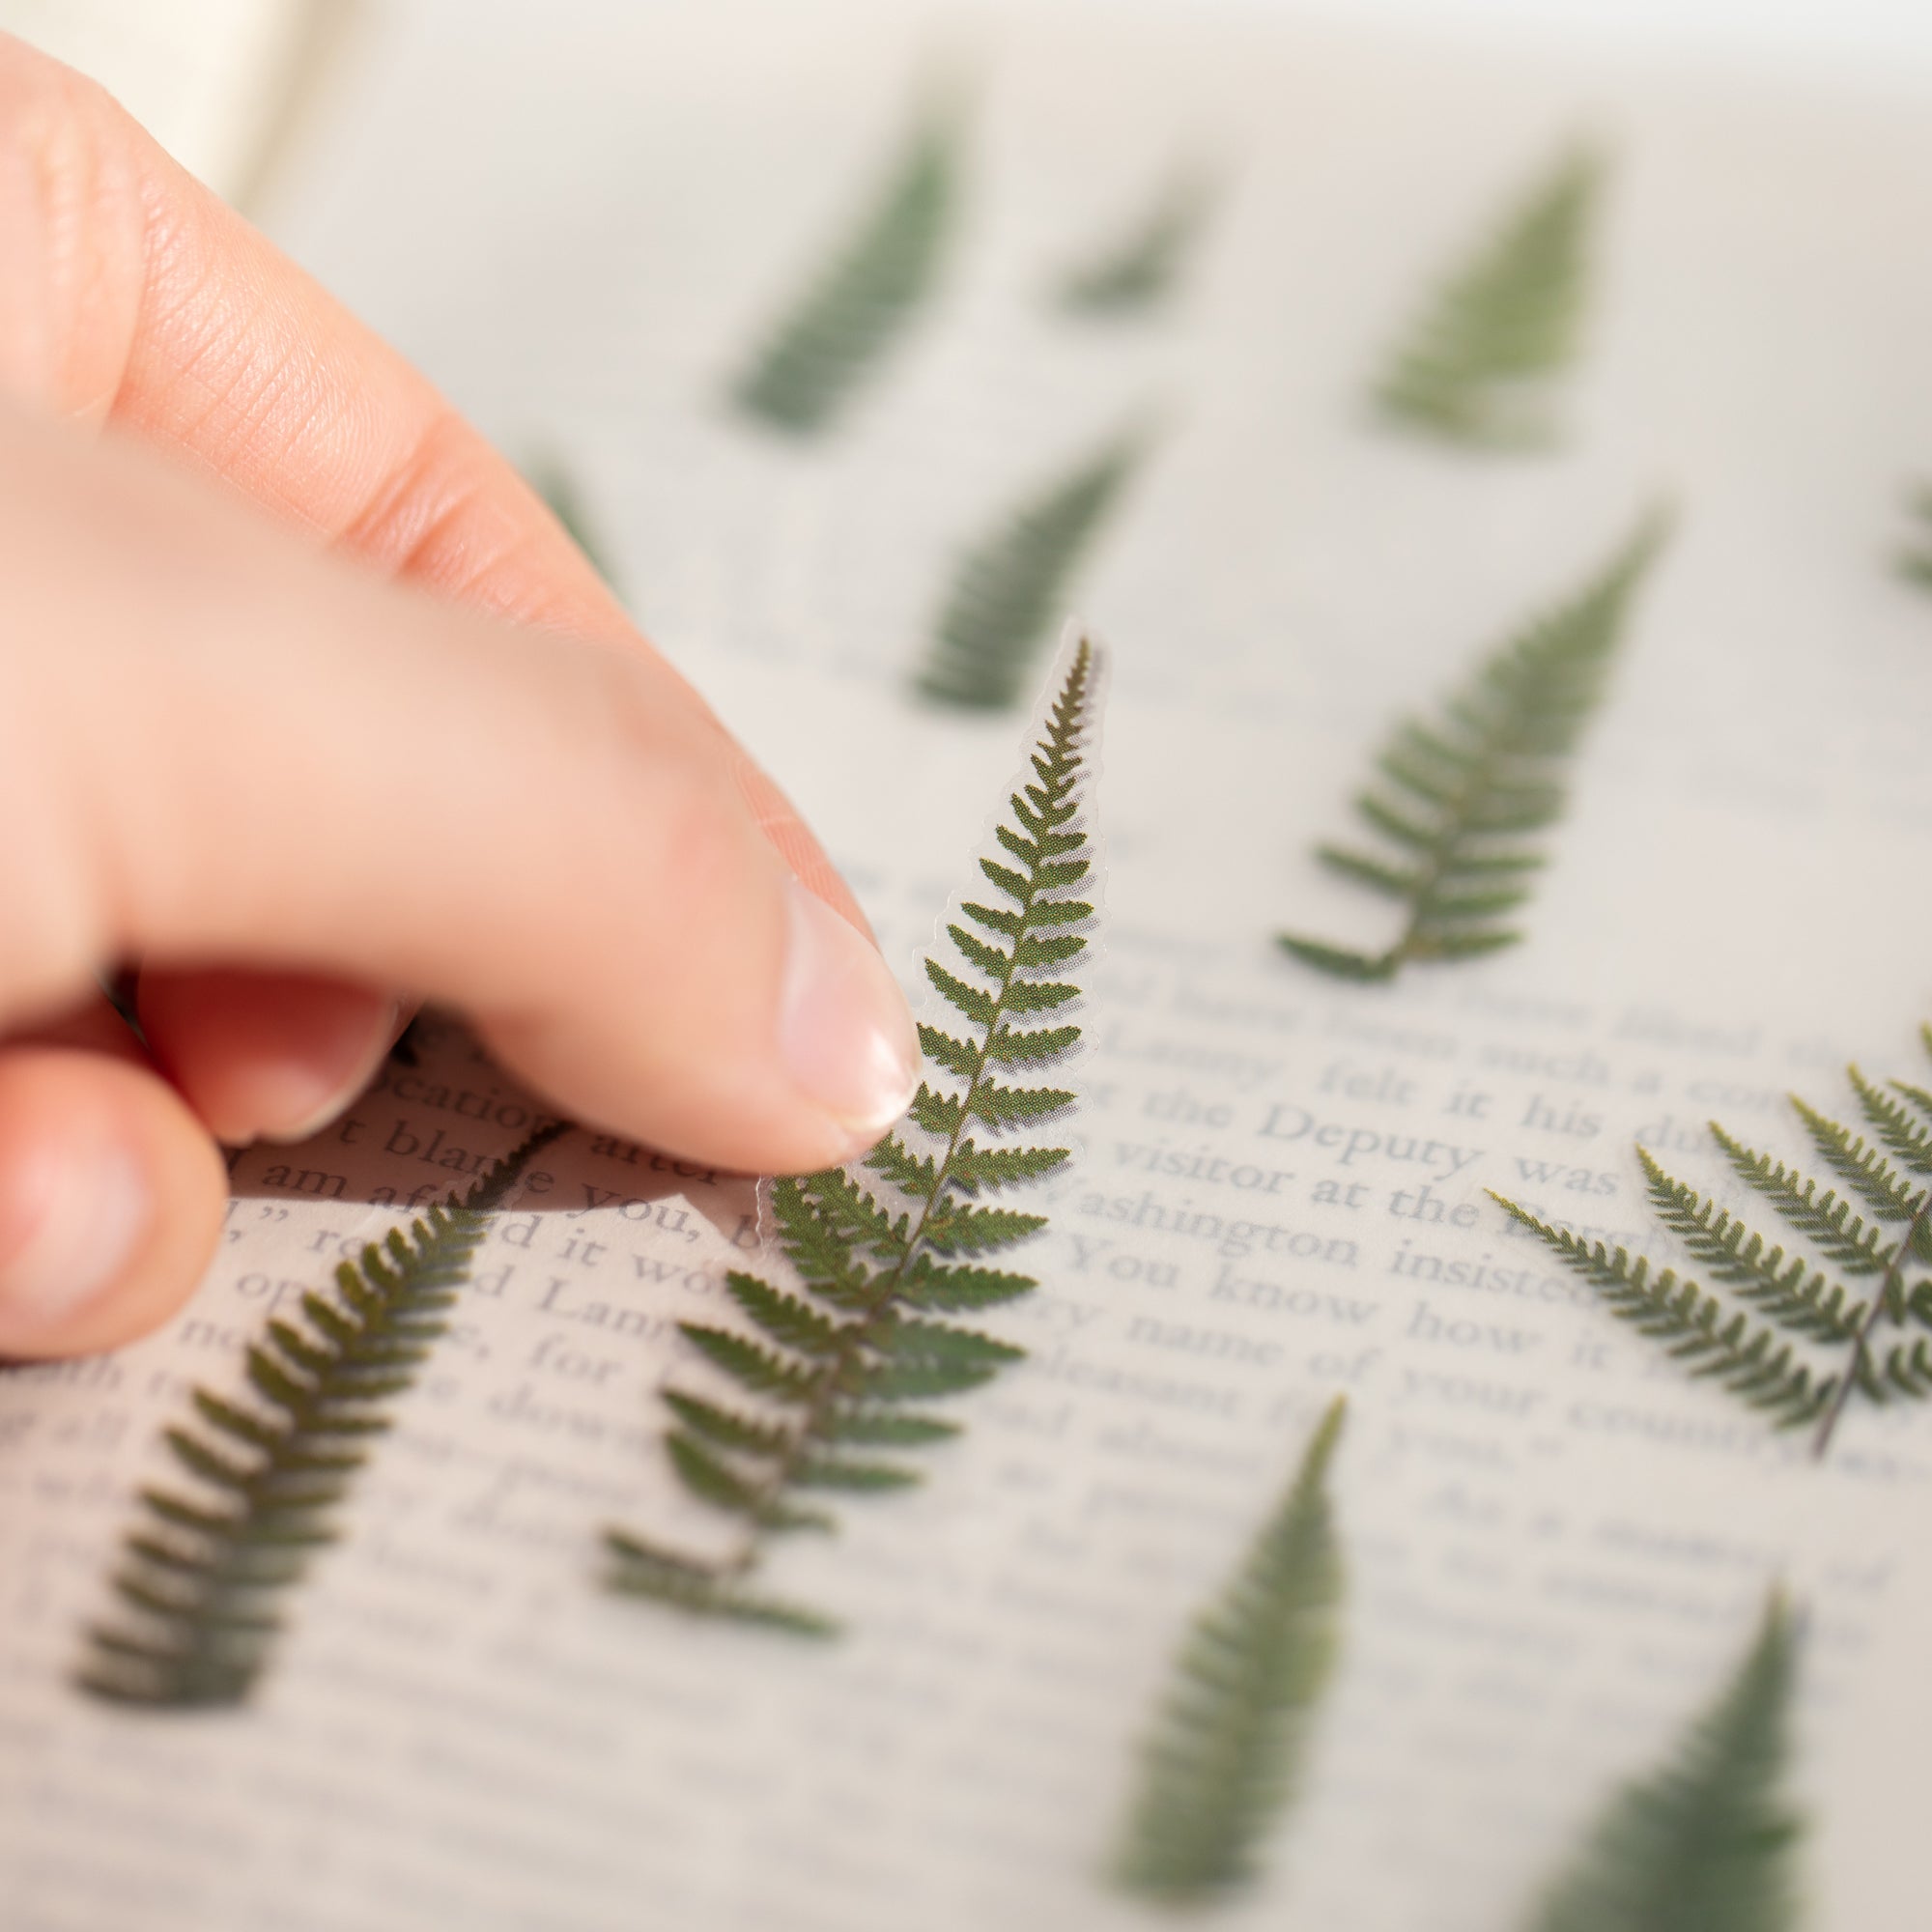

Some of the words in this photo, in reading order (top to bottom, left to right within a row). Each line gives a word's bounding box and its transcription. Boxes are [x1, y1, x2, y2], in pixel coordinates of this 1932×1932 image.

[1139, 1082, 1237, 1132] the
[1256, 1103, 1488, 1182] Deputy
[1511, 1155, 1625, 1200] was
[1314, 1057, 1422, 1111] felt
[1443, 1076, 1493, 1122] it
[1519, 1092, 1605, 1142] his
[263, 1161, 350, 1198] am
[554, 1225, 609, 1269] it
[1049, 1173, 1359, 1267] ashington
[1112, 1134, 1296, 1198] visitor
[1310, 1175, 1372, 1213] at
[1387, 1180, 1484, 1231] the
[578, 1180, 701, 1246] you,
[1124, 1312, 1287, 1372] name
[1306, 1347, 1383, 1383] of
[1391, 1362, 1549, 1422] your
[1065, 1232, 1182, 1293] You
[1208, 1262, 1381, 1327] know
[1404, 1298, 1548, 1356] how
[1565, 1329, 1611, 1376] it
[526, 1329, 624, 1387] for
